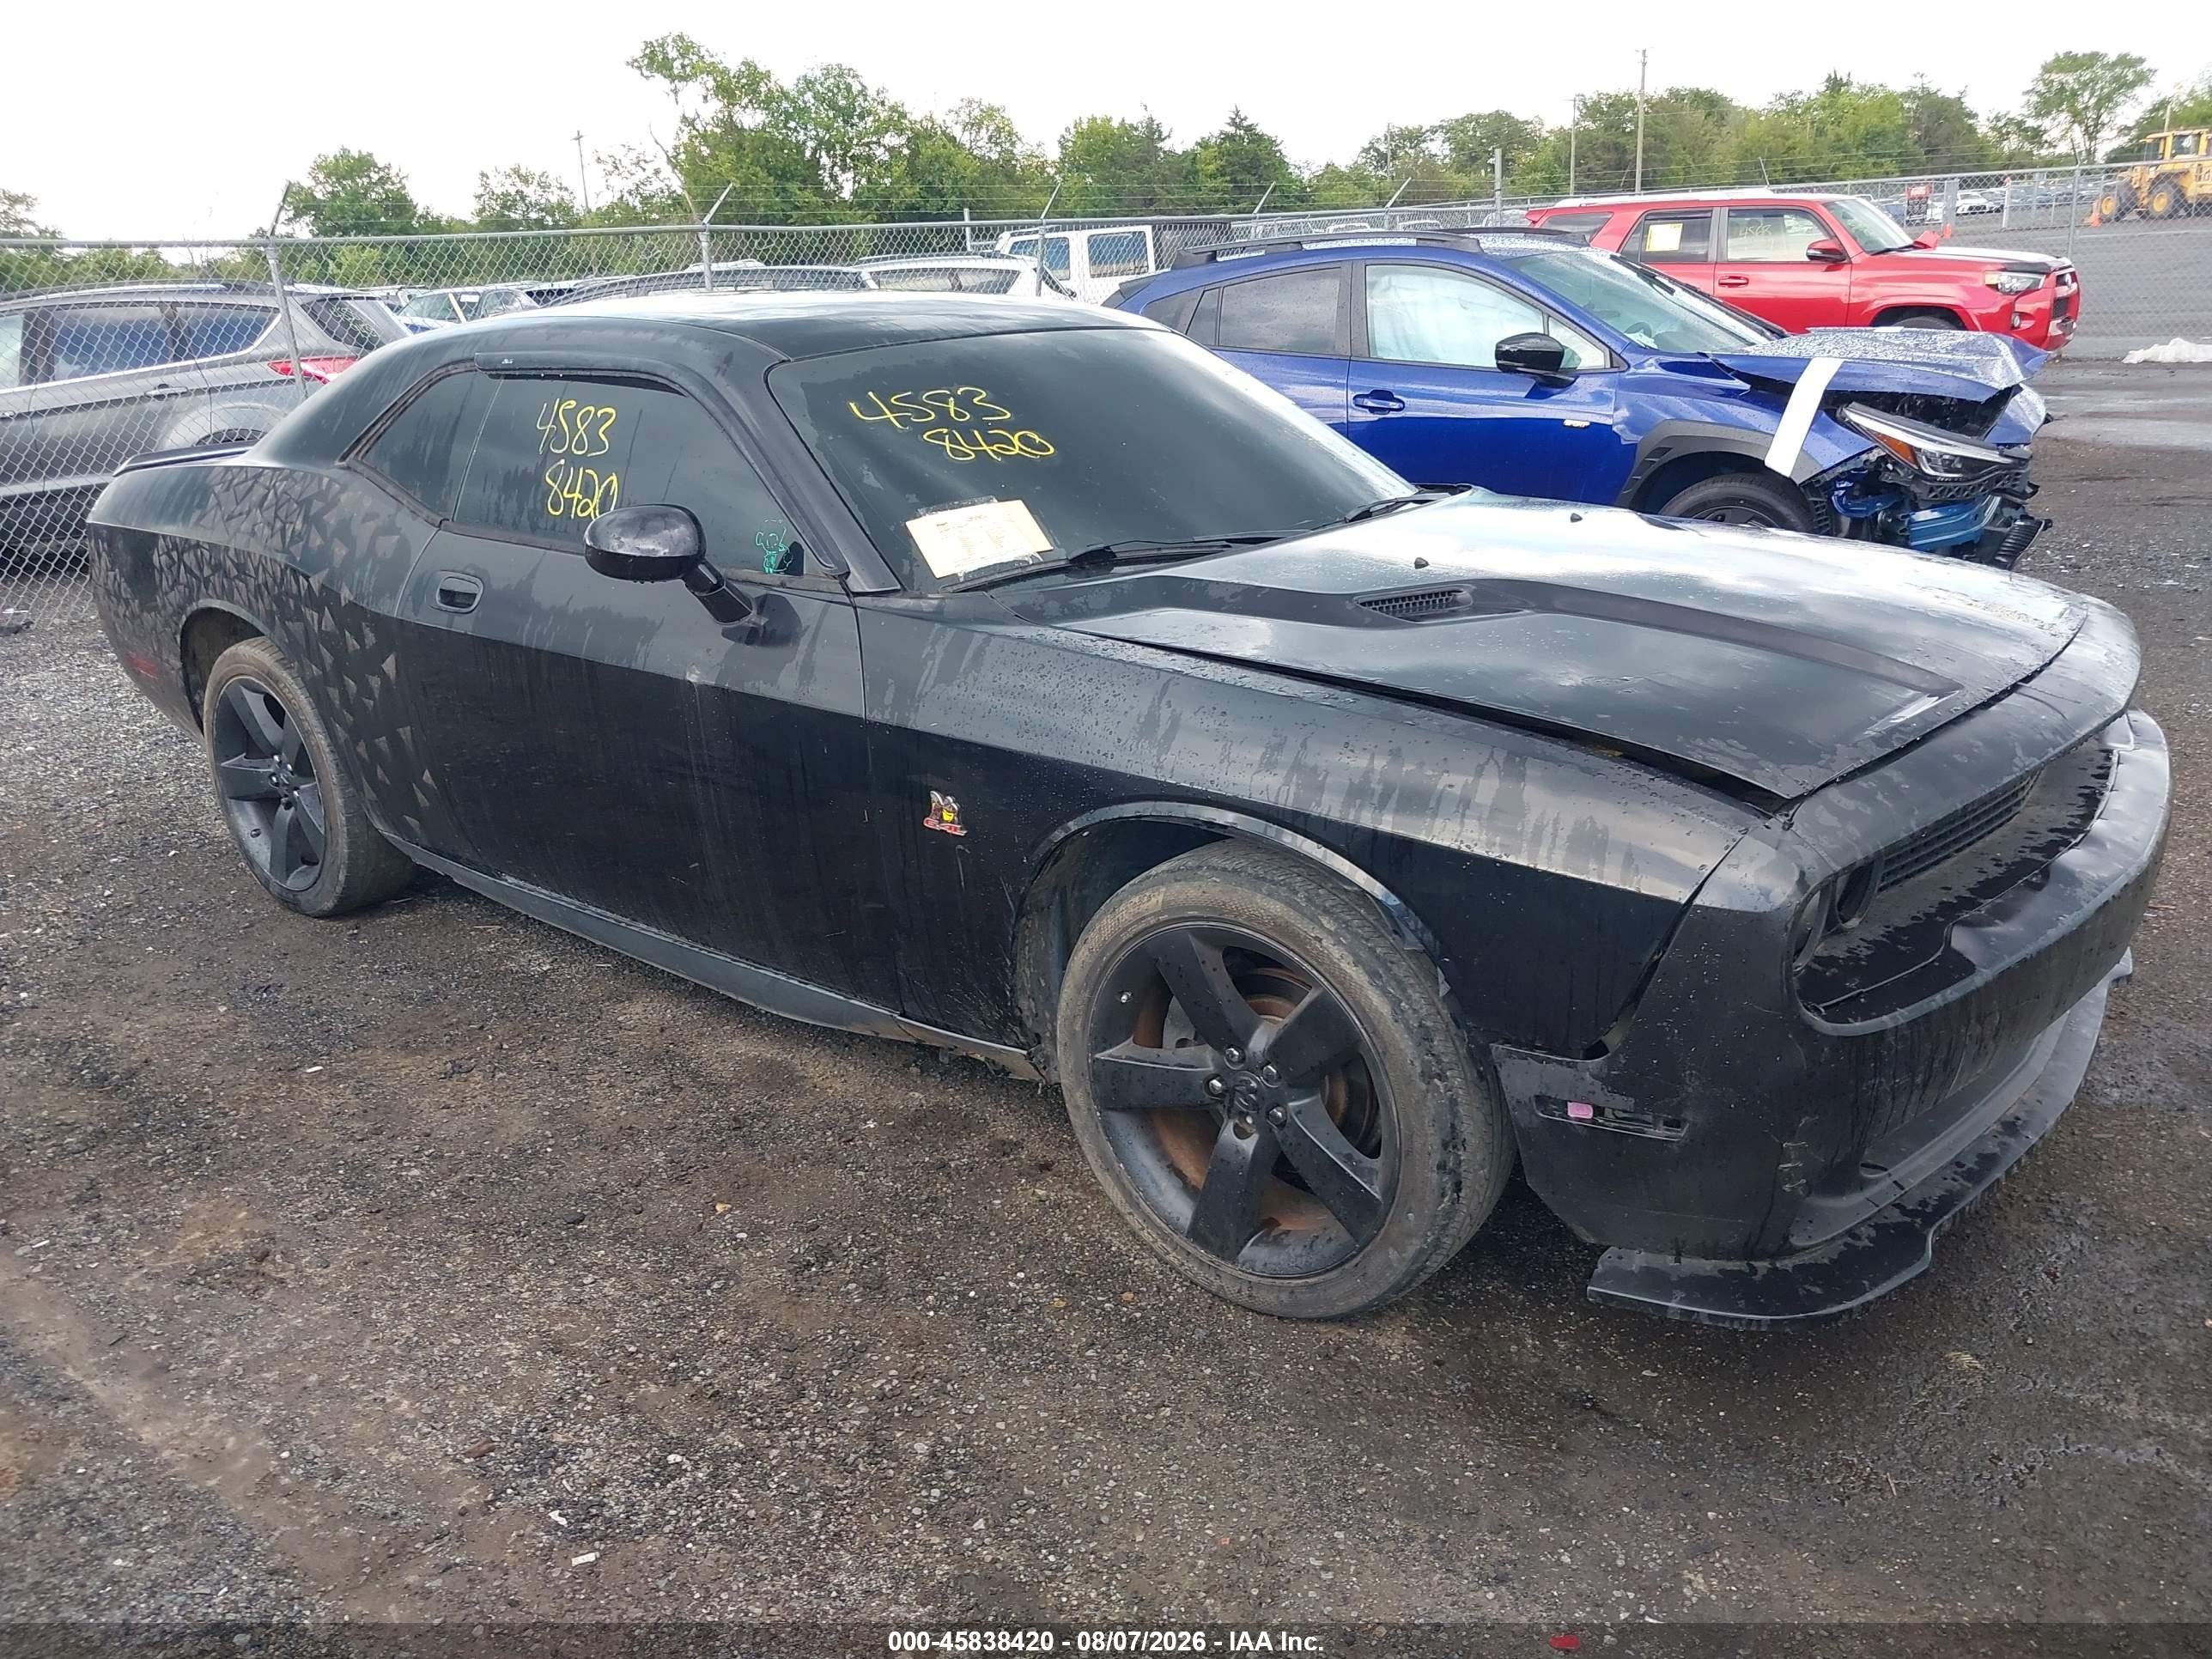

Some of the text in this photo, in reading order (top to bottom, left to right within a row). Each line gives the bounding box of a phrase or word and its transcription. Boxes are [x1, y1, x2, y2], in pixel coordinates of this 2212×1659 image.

[537, 398, 617, 457] 4583
[848, 386, 1012, 430] 4583
[922, 428, 1054, 461] 8420
[545, 458, 618, 520] 8420
